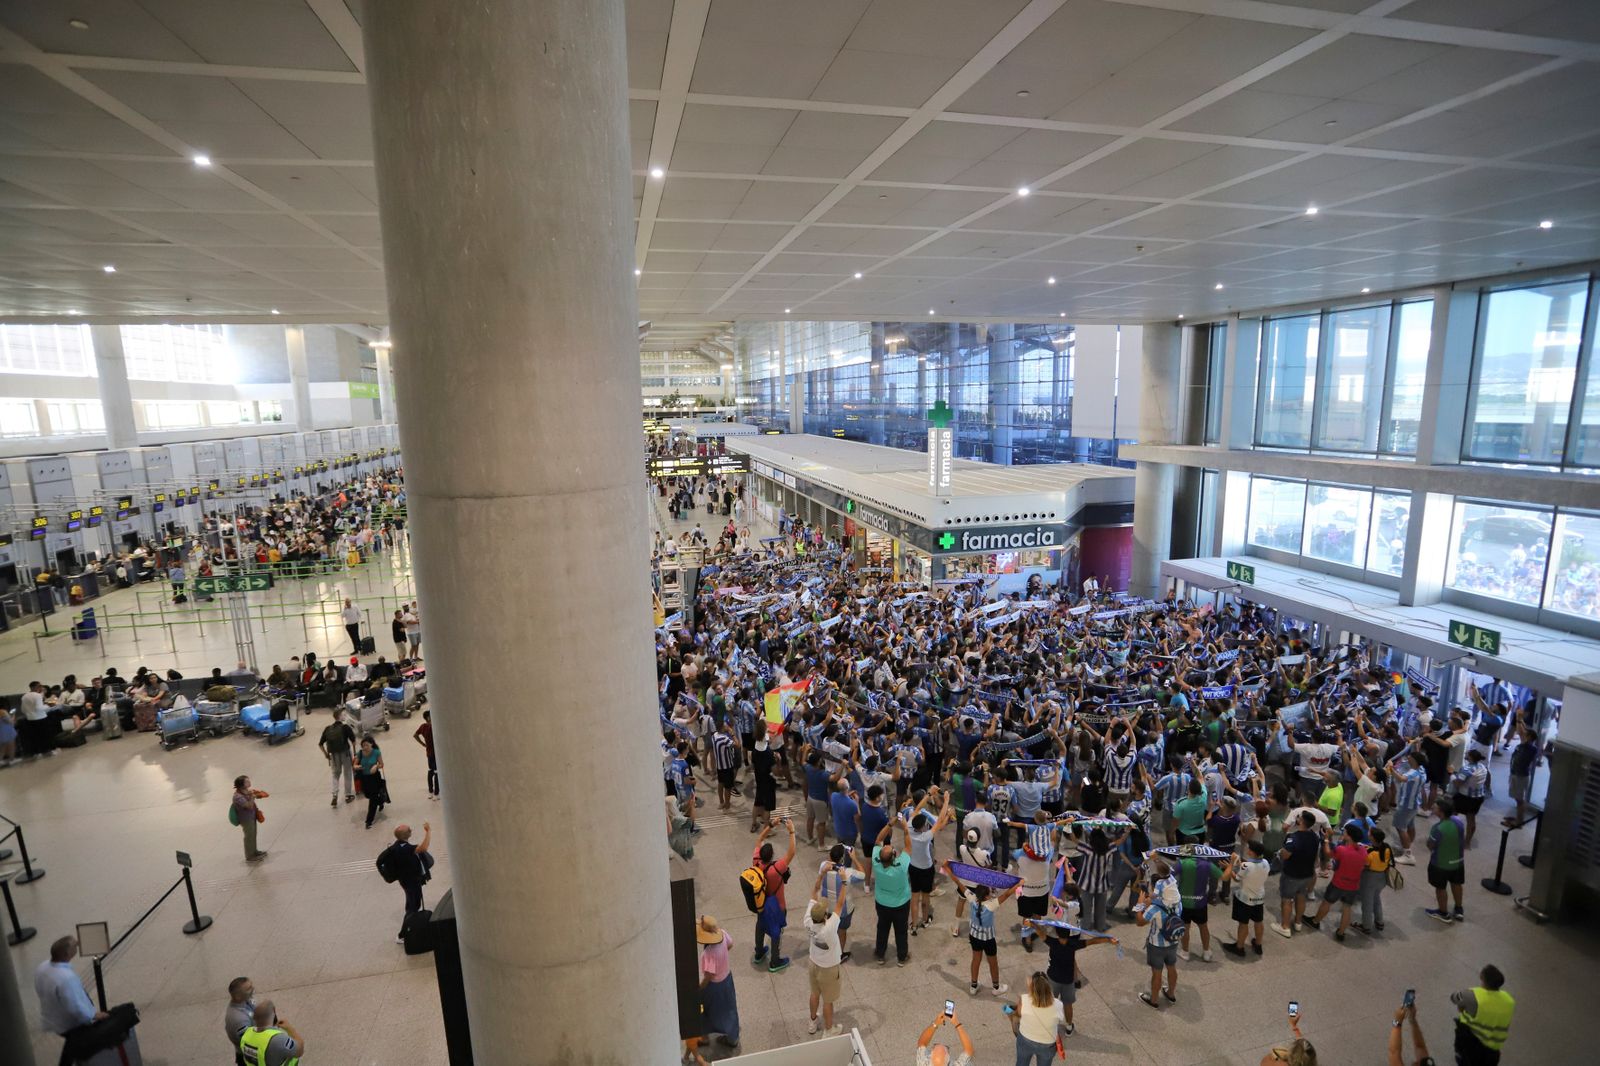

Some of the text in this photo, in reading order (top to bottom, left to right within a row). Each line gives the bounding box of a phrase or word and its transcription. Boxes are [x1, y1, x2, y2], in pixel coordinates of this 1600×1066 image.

[940, 431, 951, 488] farmacia
[34, 518, 48, 527] 306
[70, 511, 81, 519] 307
[859, 505, 889, 532] farmacia
[962, 527, 1055, 550] farmacia
[993, 799, 1009, 813] 33
